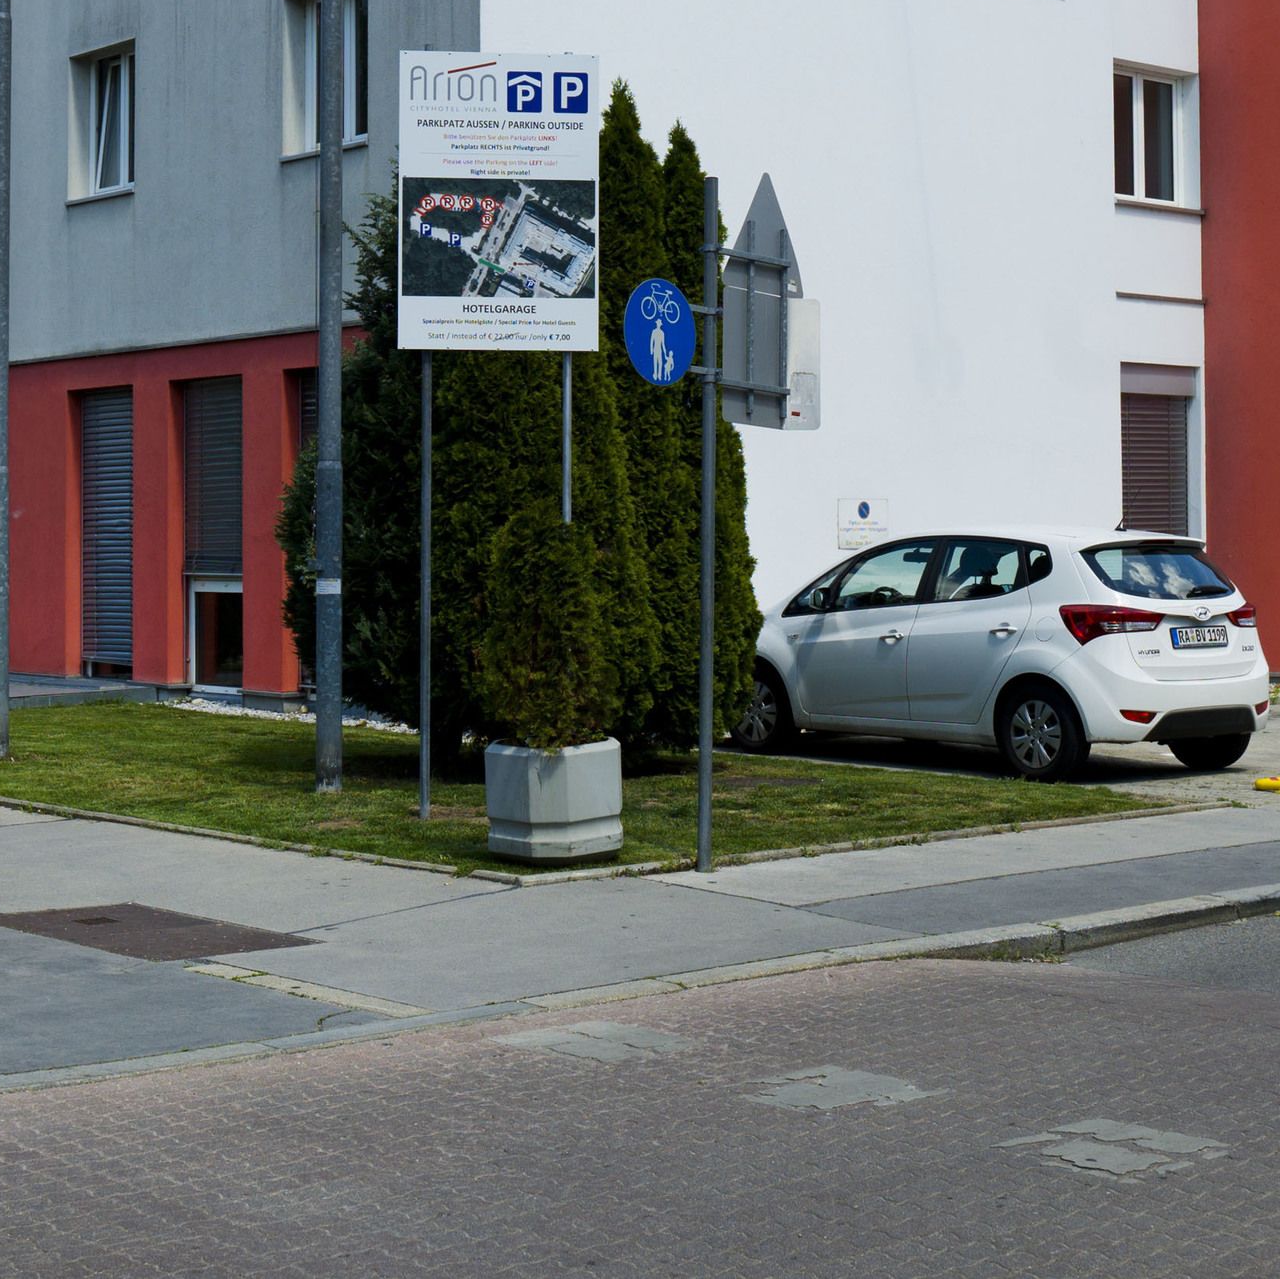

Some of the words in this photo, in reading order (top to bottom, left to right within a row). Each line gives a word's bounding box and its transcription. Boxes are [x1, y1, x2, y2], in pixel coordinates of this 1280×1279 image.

[410, 63, 497, 102] Arion
[561, 76, 583, 109] P
[417, 119, 464, 128] PARKLPATZ
[466, 120, 499, 129] AUSSEN
[508, 120, 545, 130] PARKING
[547, 121, 584, 131] OUTSIDE
[451, 143, 479, 151] Parkplatz
[462, 304, 537, 314] HOTELGARAGE
[428, 332, 445, 340] Statt
[452, 332, 478, 340] instead
[1178, 629, 1191, 644] RA
[1195, 629, 1207, 642] BV
[1208, 628, 1226, 642] 1199
